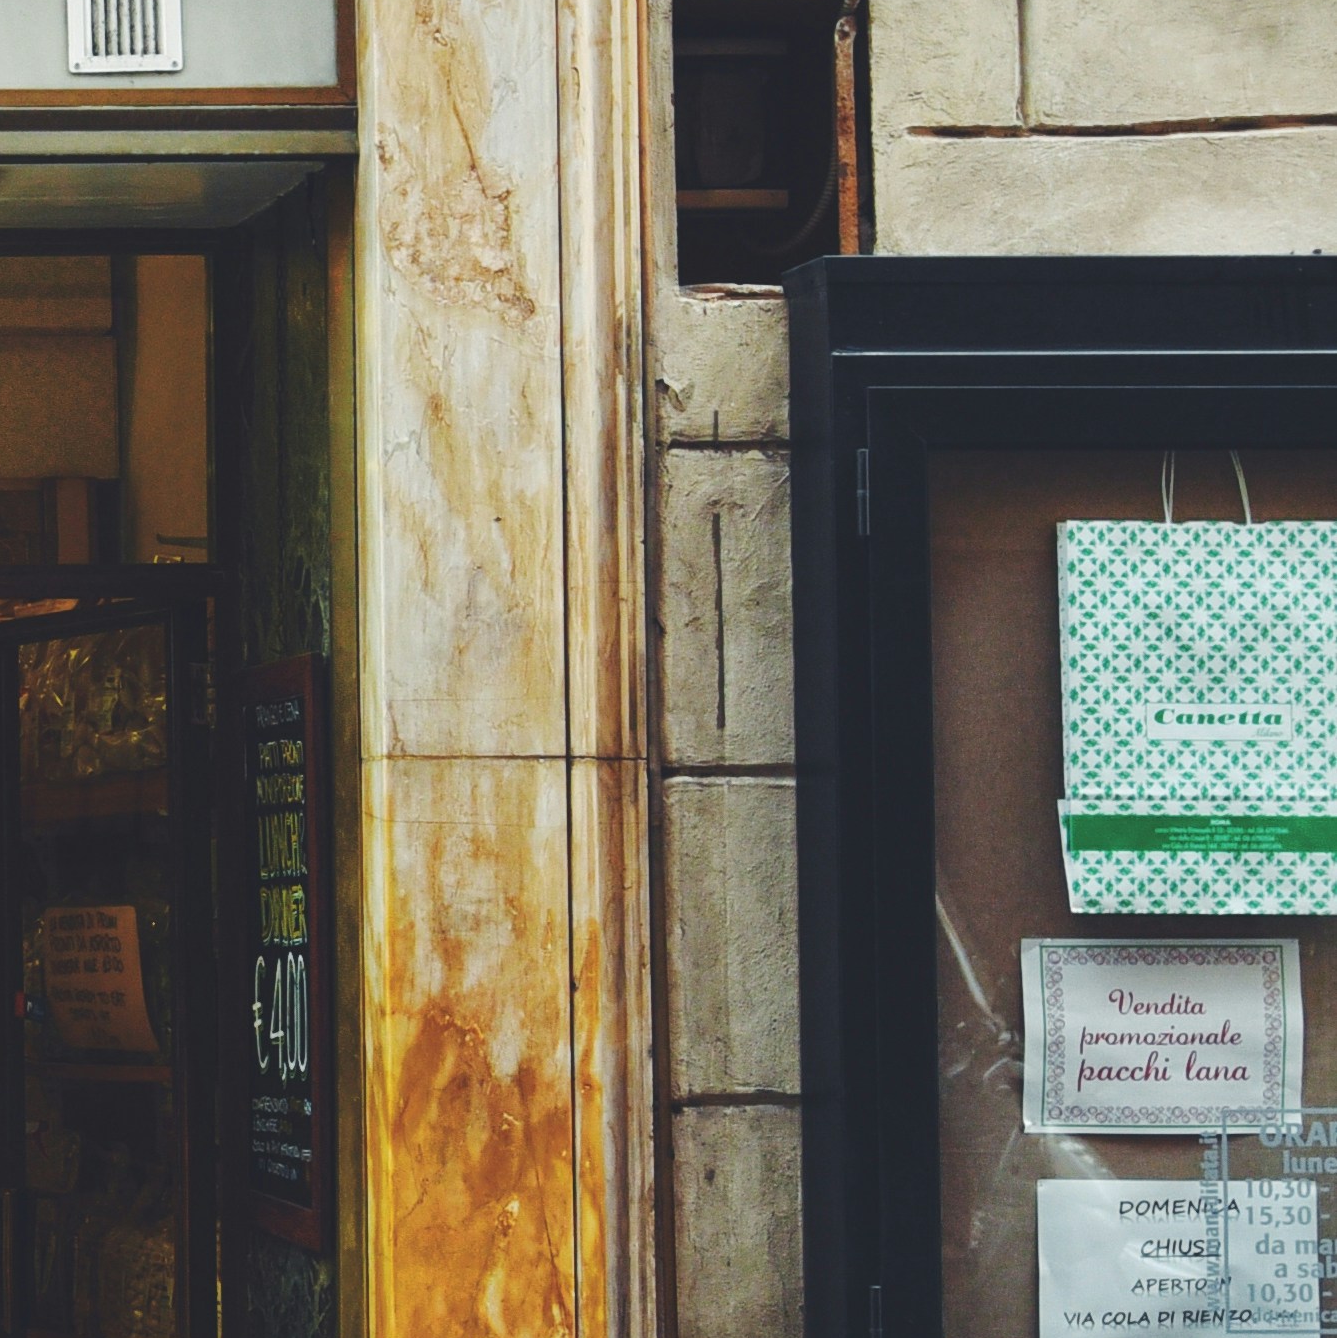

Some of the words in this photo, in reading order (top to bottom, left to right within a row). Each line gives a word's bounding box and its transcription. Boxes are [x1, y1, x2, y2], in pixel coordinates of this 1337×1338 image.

[1153, 708, 1284, 726] Canetta
[1108, 988, 1206, 1016] Vendita
[1079, 1019, 1243, 1055] promozionale
[1077, 1050, 1172, 1092] pacchi
[1184, 1050, 1250, 1082] lana
[1259, 1122, 1337, 1149] ORA
[1245, 1178, 1312, 1202] 10,30
[1118, 1198, 1241, 1217] DOMENICA
[1245, 1205, 1312, 1229] 15,30
[1255, 1232, 1286, 1256] da
[1274, 1263, 1288, 1279] a
[1131, 1277, 1208, 1293] APERTO
[1247, 1283, 1314, 1307] 10,30
[1063, 1311, 1095, 1326] VIA
[1101, 1311, 1151, 1326] COLA
[1157, 1310, 1176, 1325] DI
